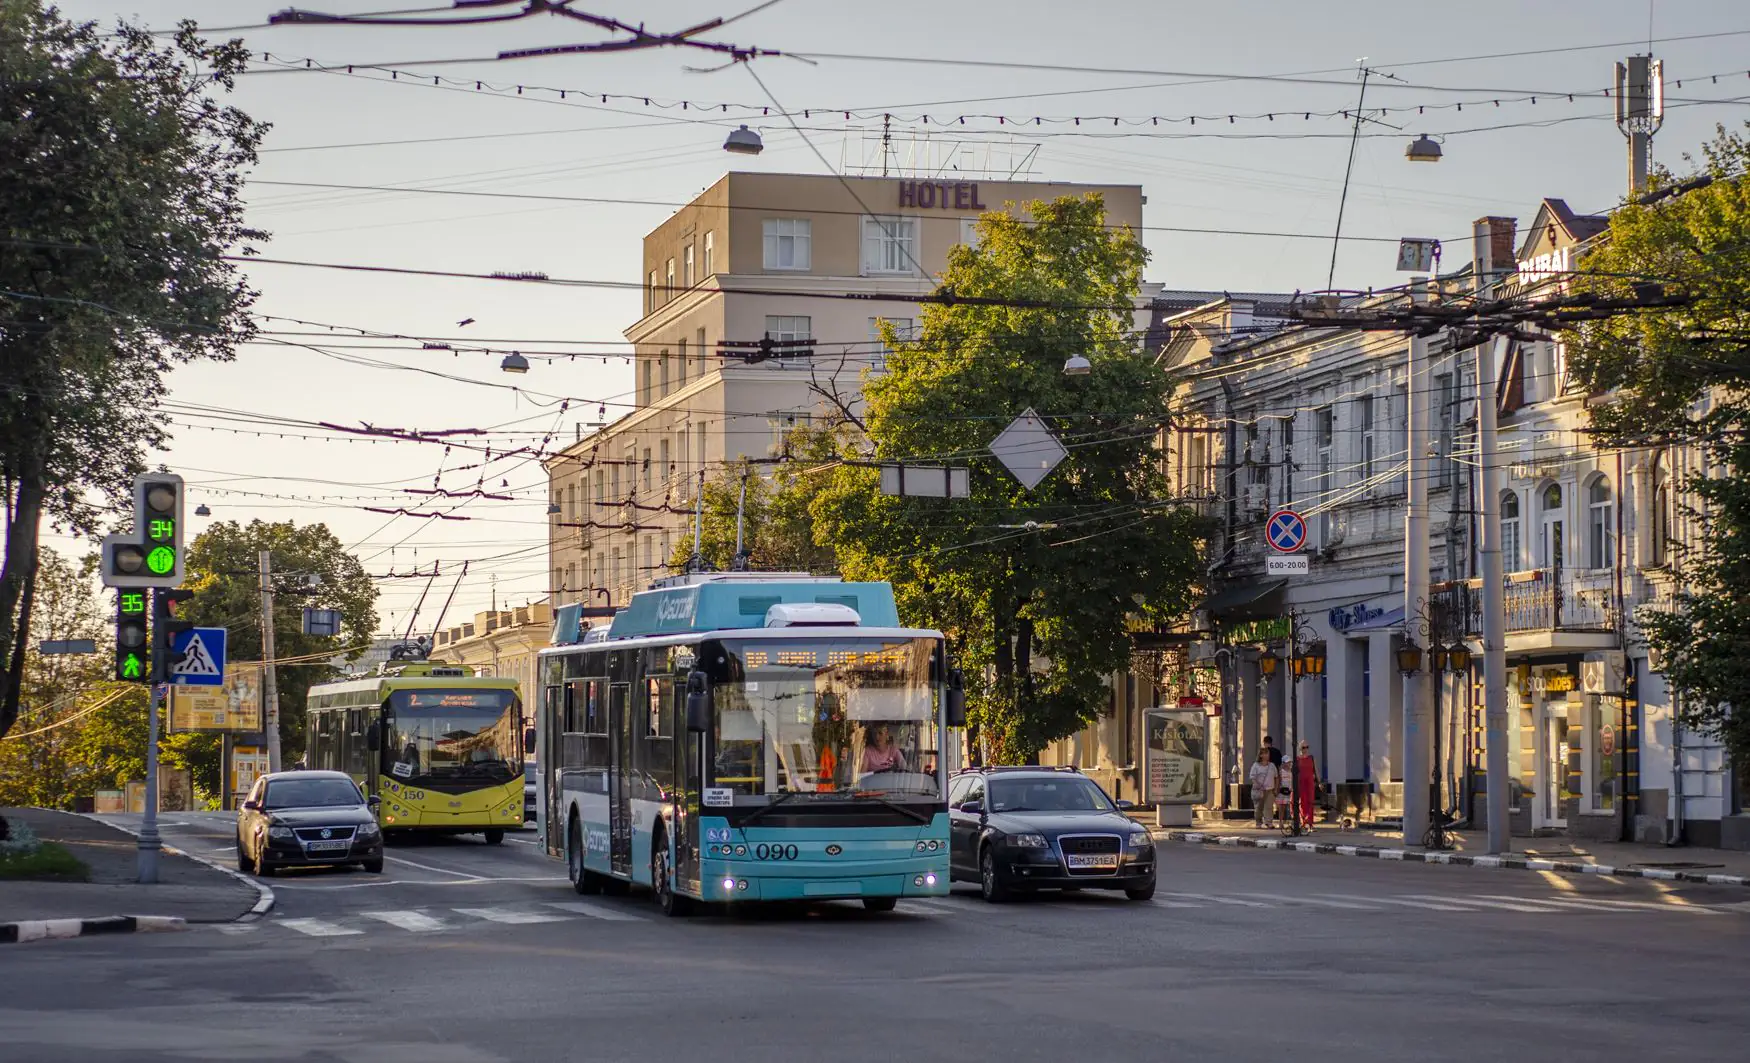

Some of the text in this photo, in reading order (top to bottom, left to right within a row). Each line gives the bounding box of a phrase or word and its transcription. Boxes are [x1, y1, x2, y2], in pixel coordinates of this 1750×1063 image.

[899, 181, 986, 210] HOTEL
[1518, 246, 1568, 286] DUBAI
[151, 520, 173, 538] 34
[121, 594, 144, 612] 35
[403, 790, 425, 800] 150
[756, 843, 799, 860] 090
